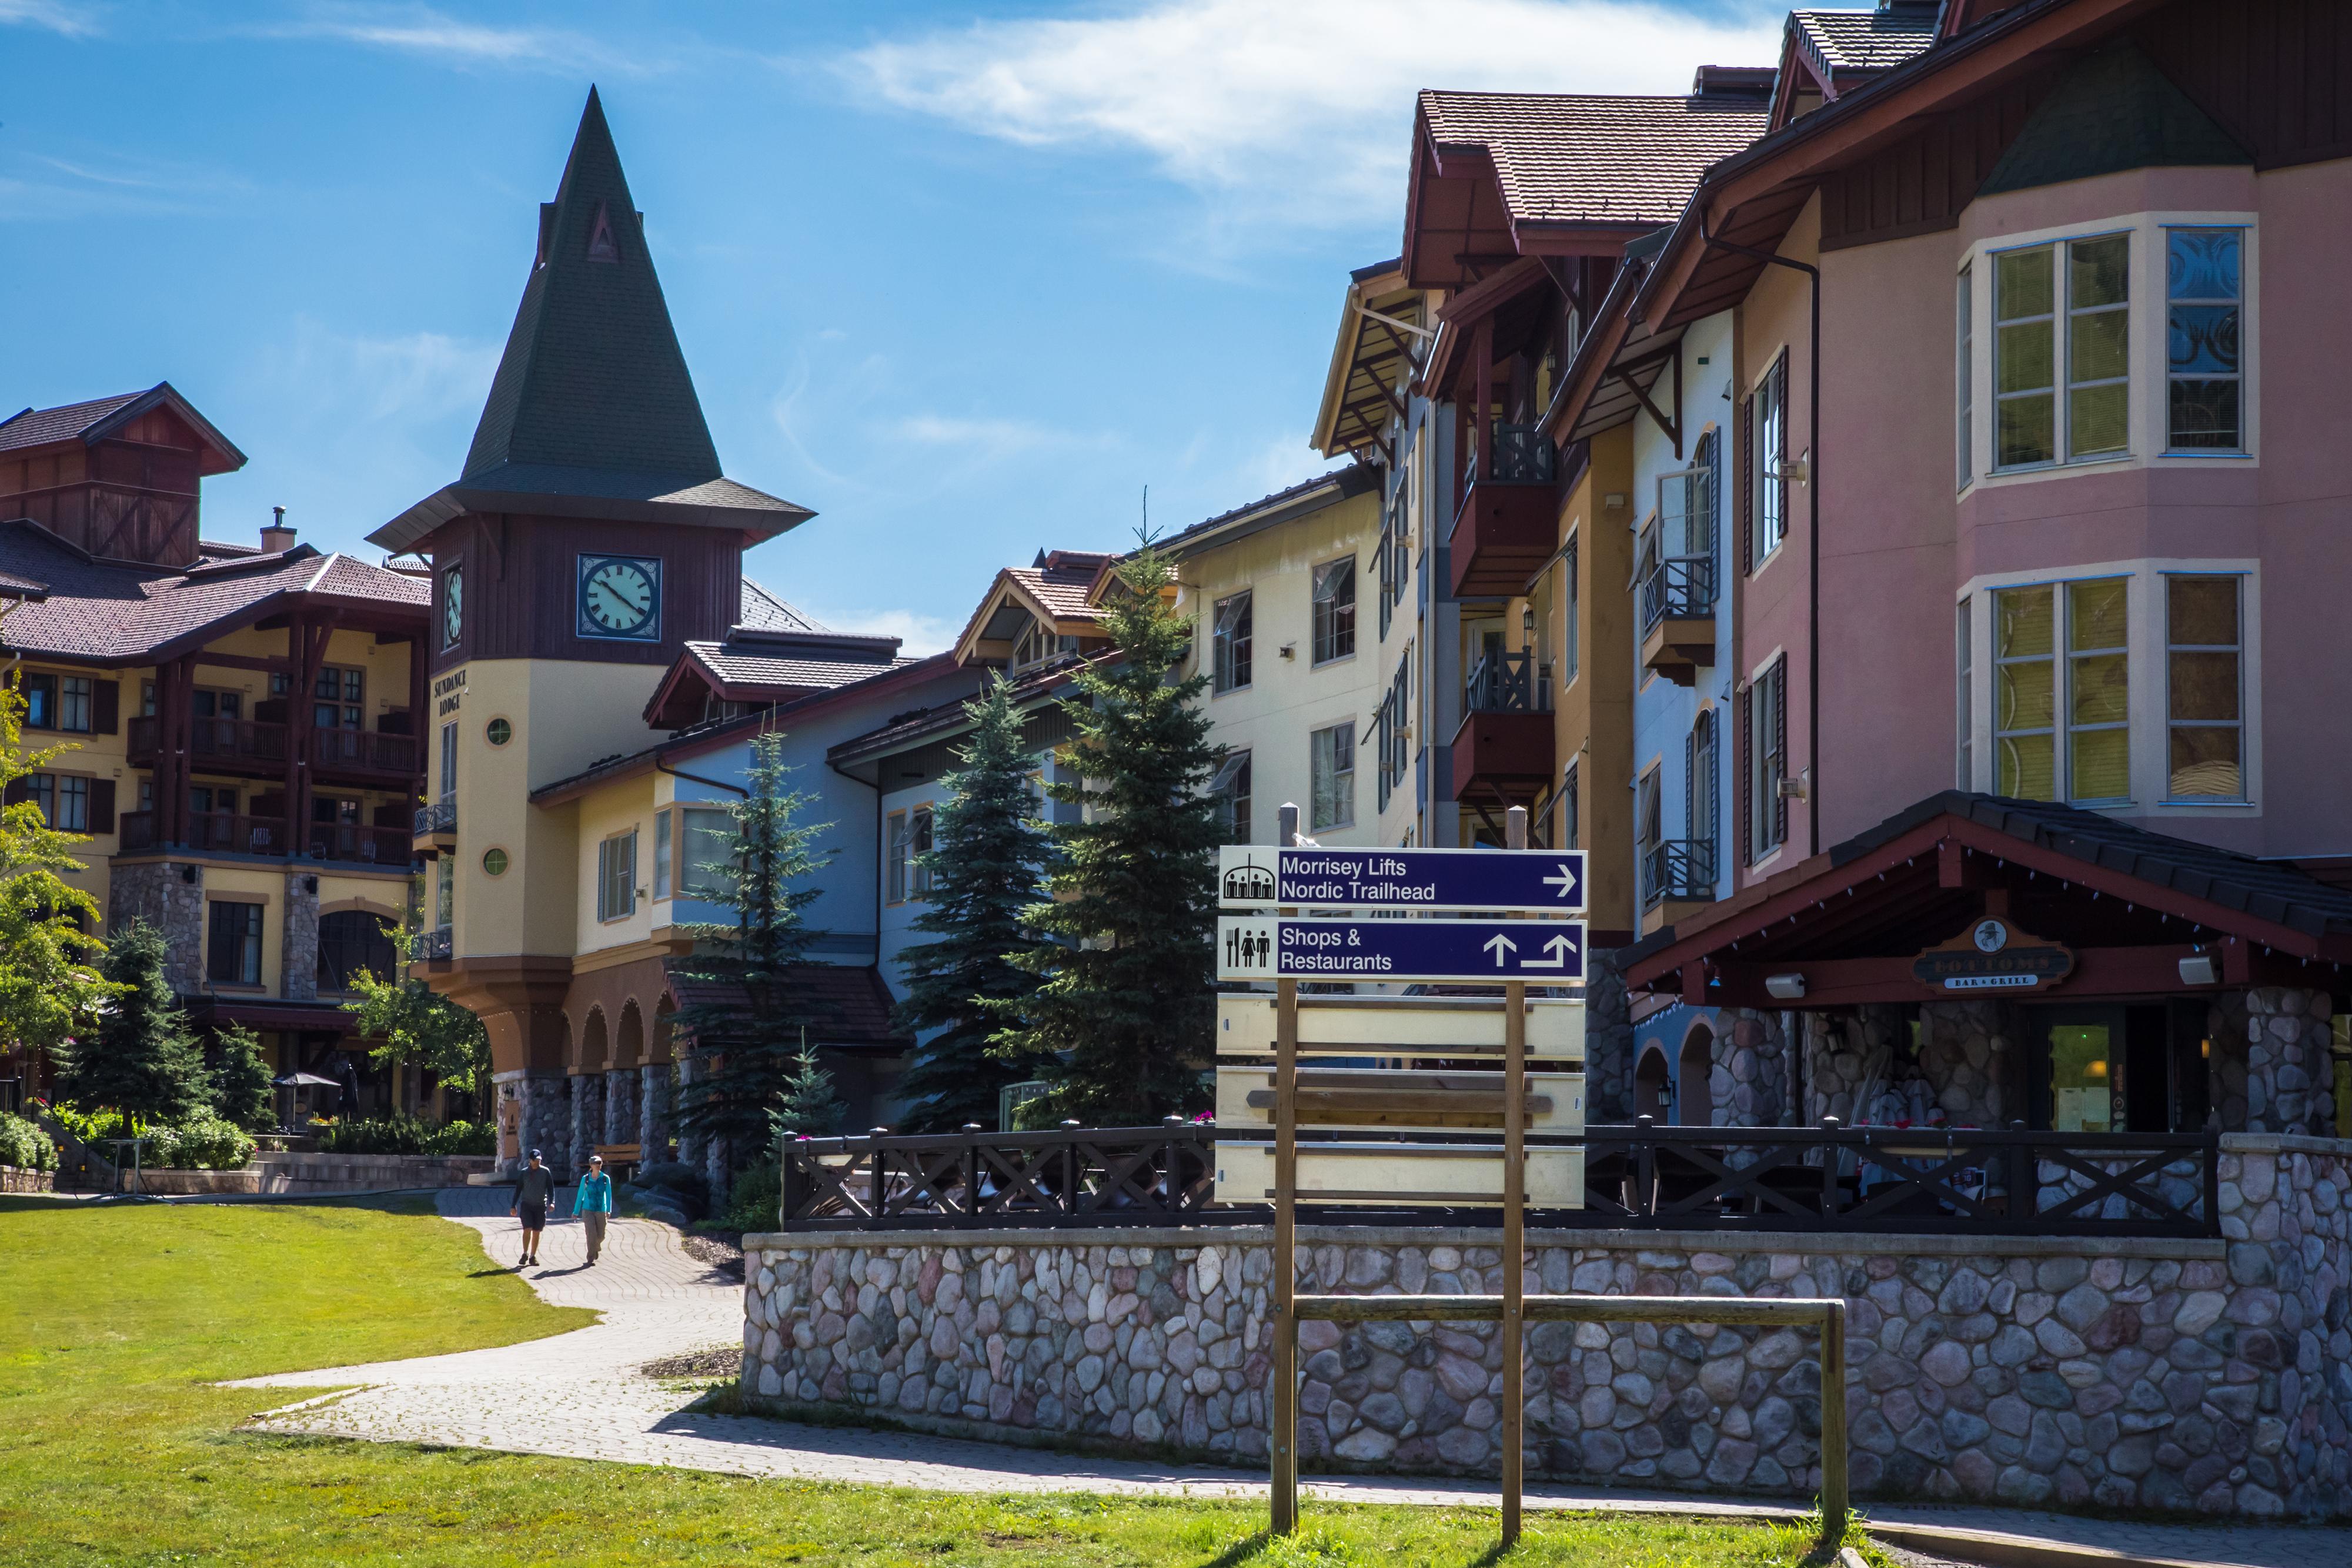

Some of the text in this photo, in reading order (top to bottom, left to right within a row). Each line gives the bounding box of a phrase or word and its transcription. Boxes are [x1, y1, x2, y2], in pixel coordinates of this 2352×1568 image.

[435, 669, 466, 698] SUNDANCE
[439, 693, 460, 717] LODGE
[1282, 857, 1406, 880] Morrisey Lifts
[1282, 881, 1435, 900] Nordic Trailhead
[1282, 928, 1361, 950] Shops &
[1281, 952, 1392, 970] Restaurants
[1935, 955, 2050, 974] BOTTOMS
[1955, 978, 1978, 987] BAR
[1990, 977, 2029, 985] GRILL
